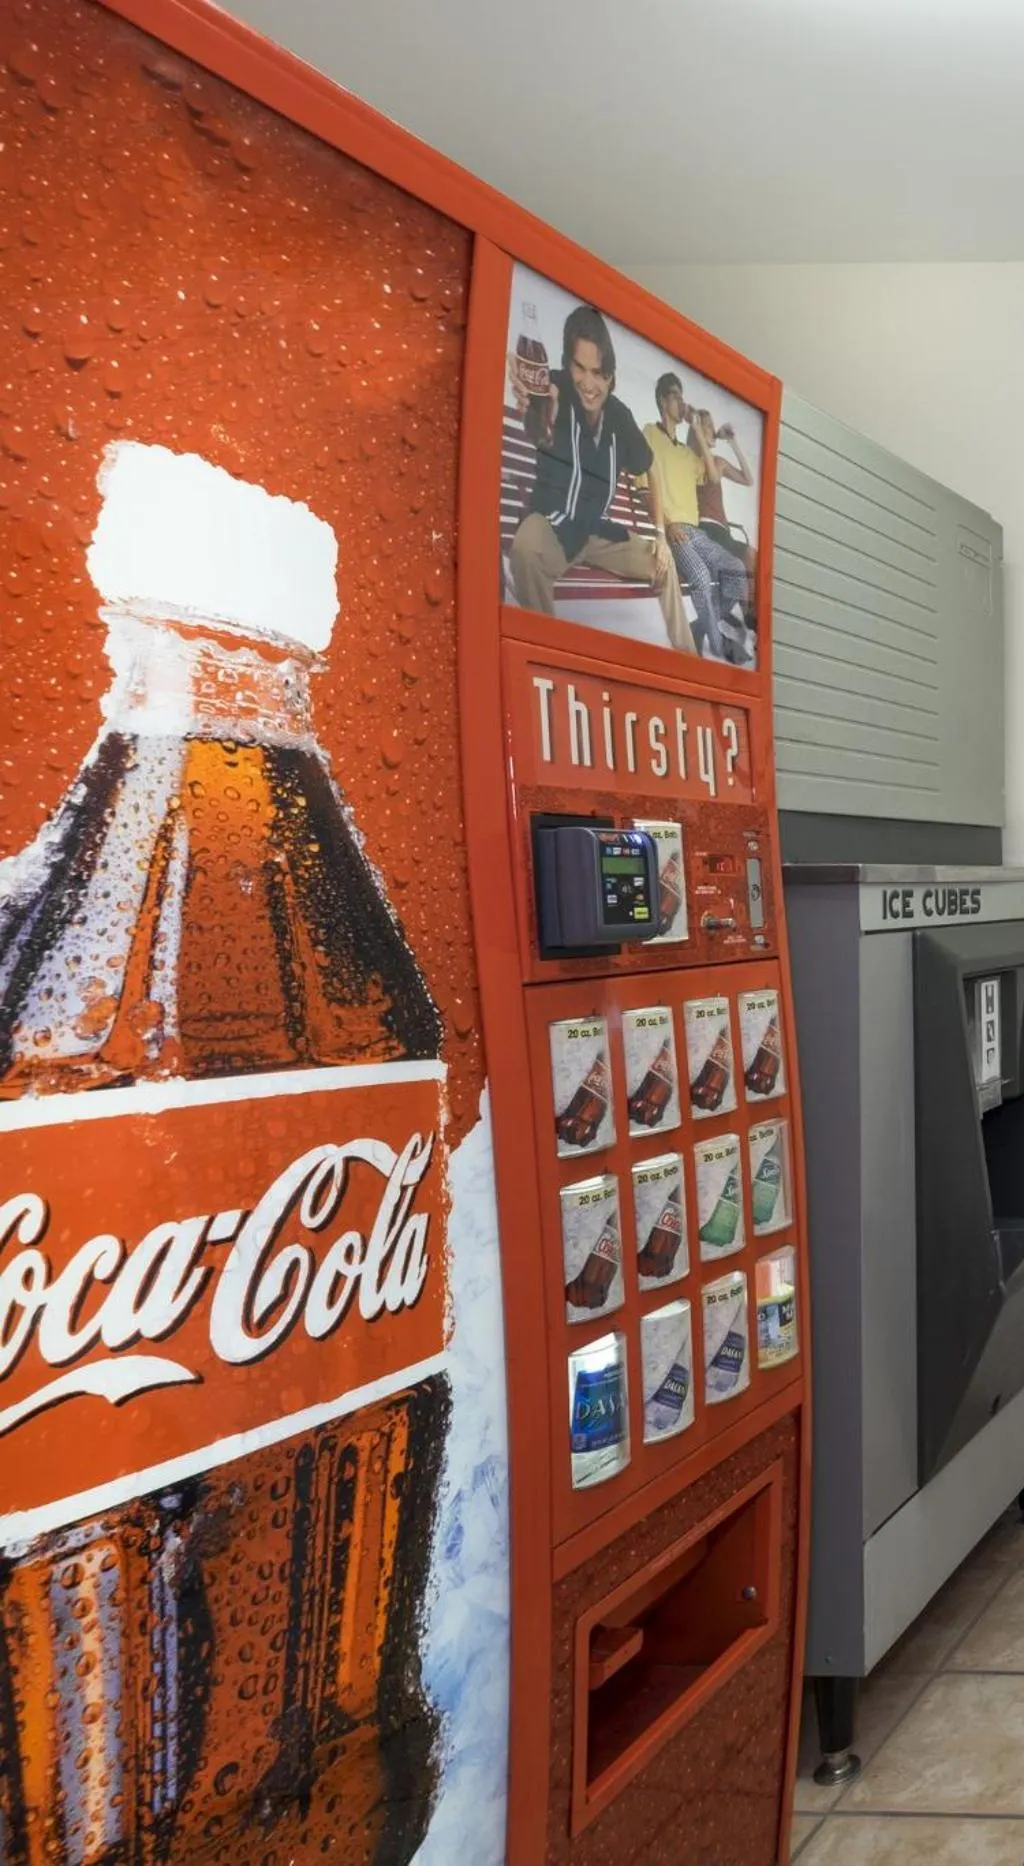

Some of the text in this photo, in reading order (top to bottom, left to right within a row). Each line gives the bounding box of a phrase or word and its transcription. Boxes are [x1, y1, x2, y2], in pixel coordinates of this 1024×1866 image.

[532, 676, 739, 797] Thirsty?
[882, 887, 982, 920] ICE CUBES
[746, 1002, 756, 1010] 20
[696, 1009, 706, 1018] 20
[636, 1018, 646, 1027] 20
[567, 1028, 579, 1039] 20
[703, 1153, 713, 1162] 20
[637, 1174, 648, 1184] 20
[579, 1194, 590, 1206] 20
[706, 1295, 717, 1305] 20
